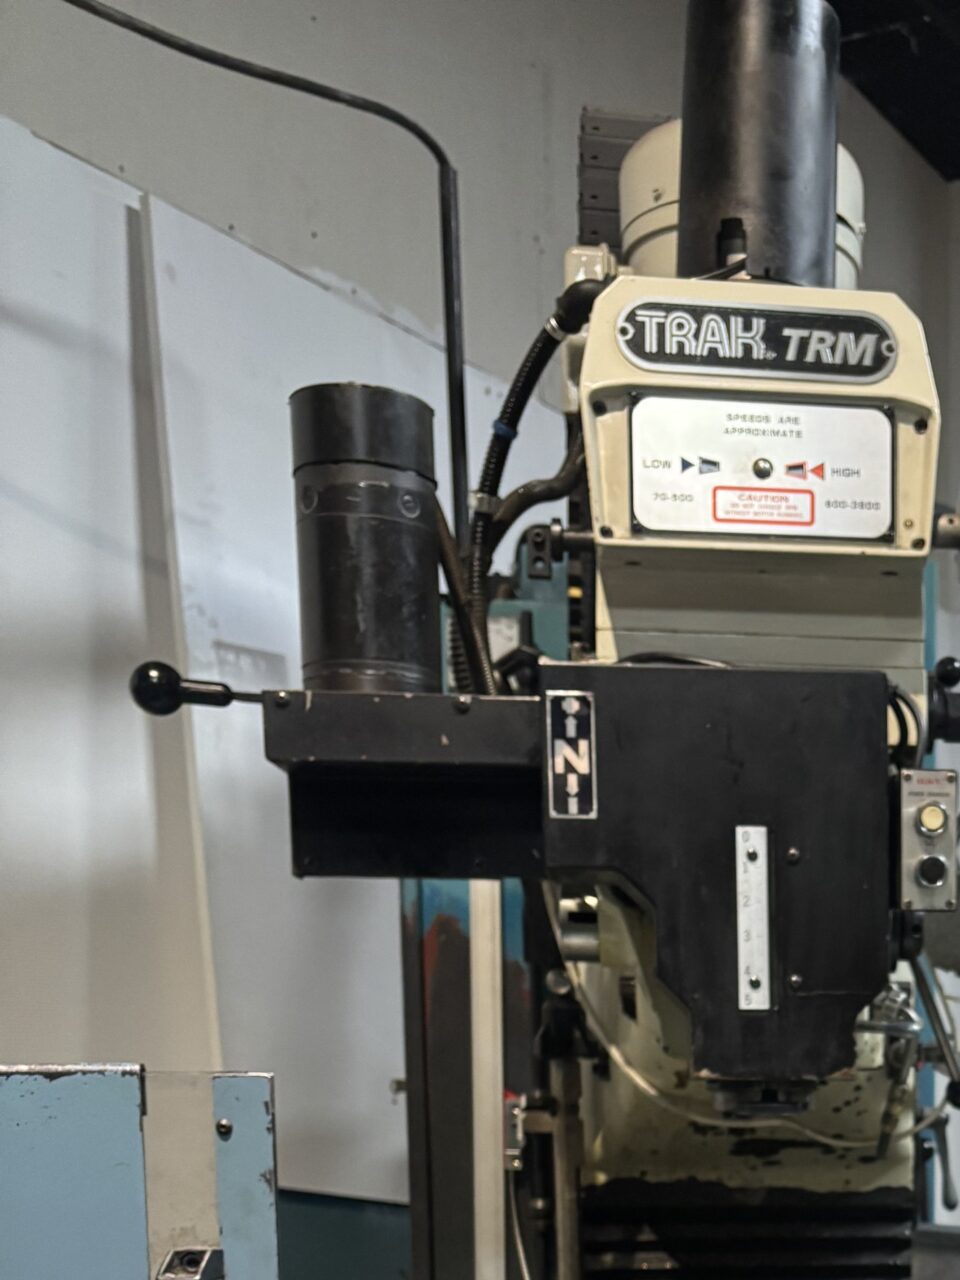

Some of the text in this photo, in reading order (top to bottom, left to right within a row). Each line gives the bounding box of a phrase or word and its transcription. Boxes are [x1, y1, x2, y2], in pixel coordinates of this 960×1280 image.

[782, 328, 880, 366] TRM
[726, 412, 800, 426] SPEEDS ARE
[723, 427, 804, 439] APPROXIMATE
[643, 460, 672, 470] LOW
[831, 468, 861, 478] HIGH
[554, 738, 590, 774] N
